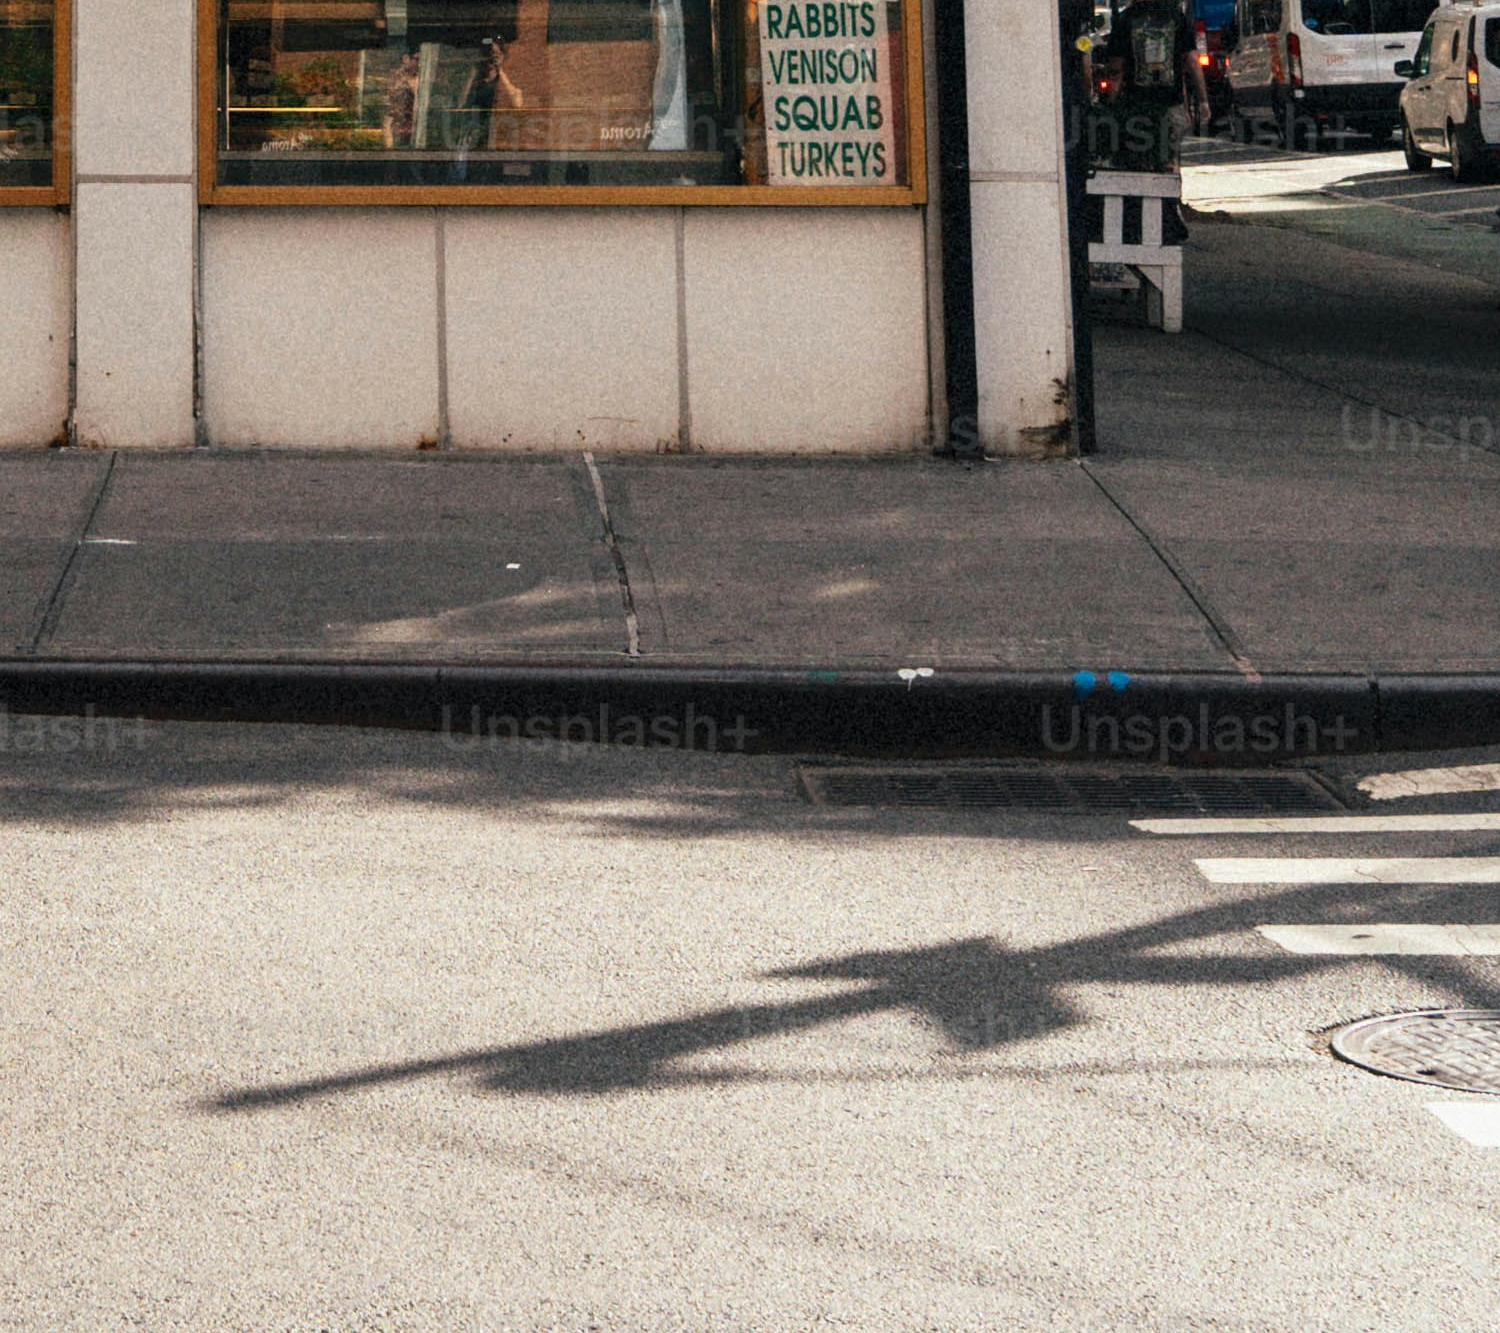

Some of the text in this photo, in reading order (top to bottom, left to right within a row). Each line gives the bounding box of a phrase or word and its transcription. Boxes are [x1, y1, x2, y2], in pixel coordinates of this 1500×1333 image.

[766, 3, 876, 40] RABBITS
[768, 47, 877, 85] VENISON
[774, 94, 883, 133] SQUAB
[777, 139, 886, 178] TURKEYS
